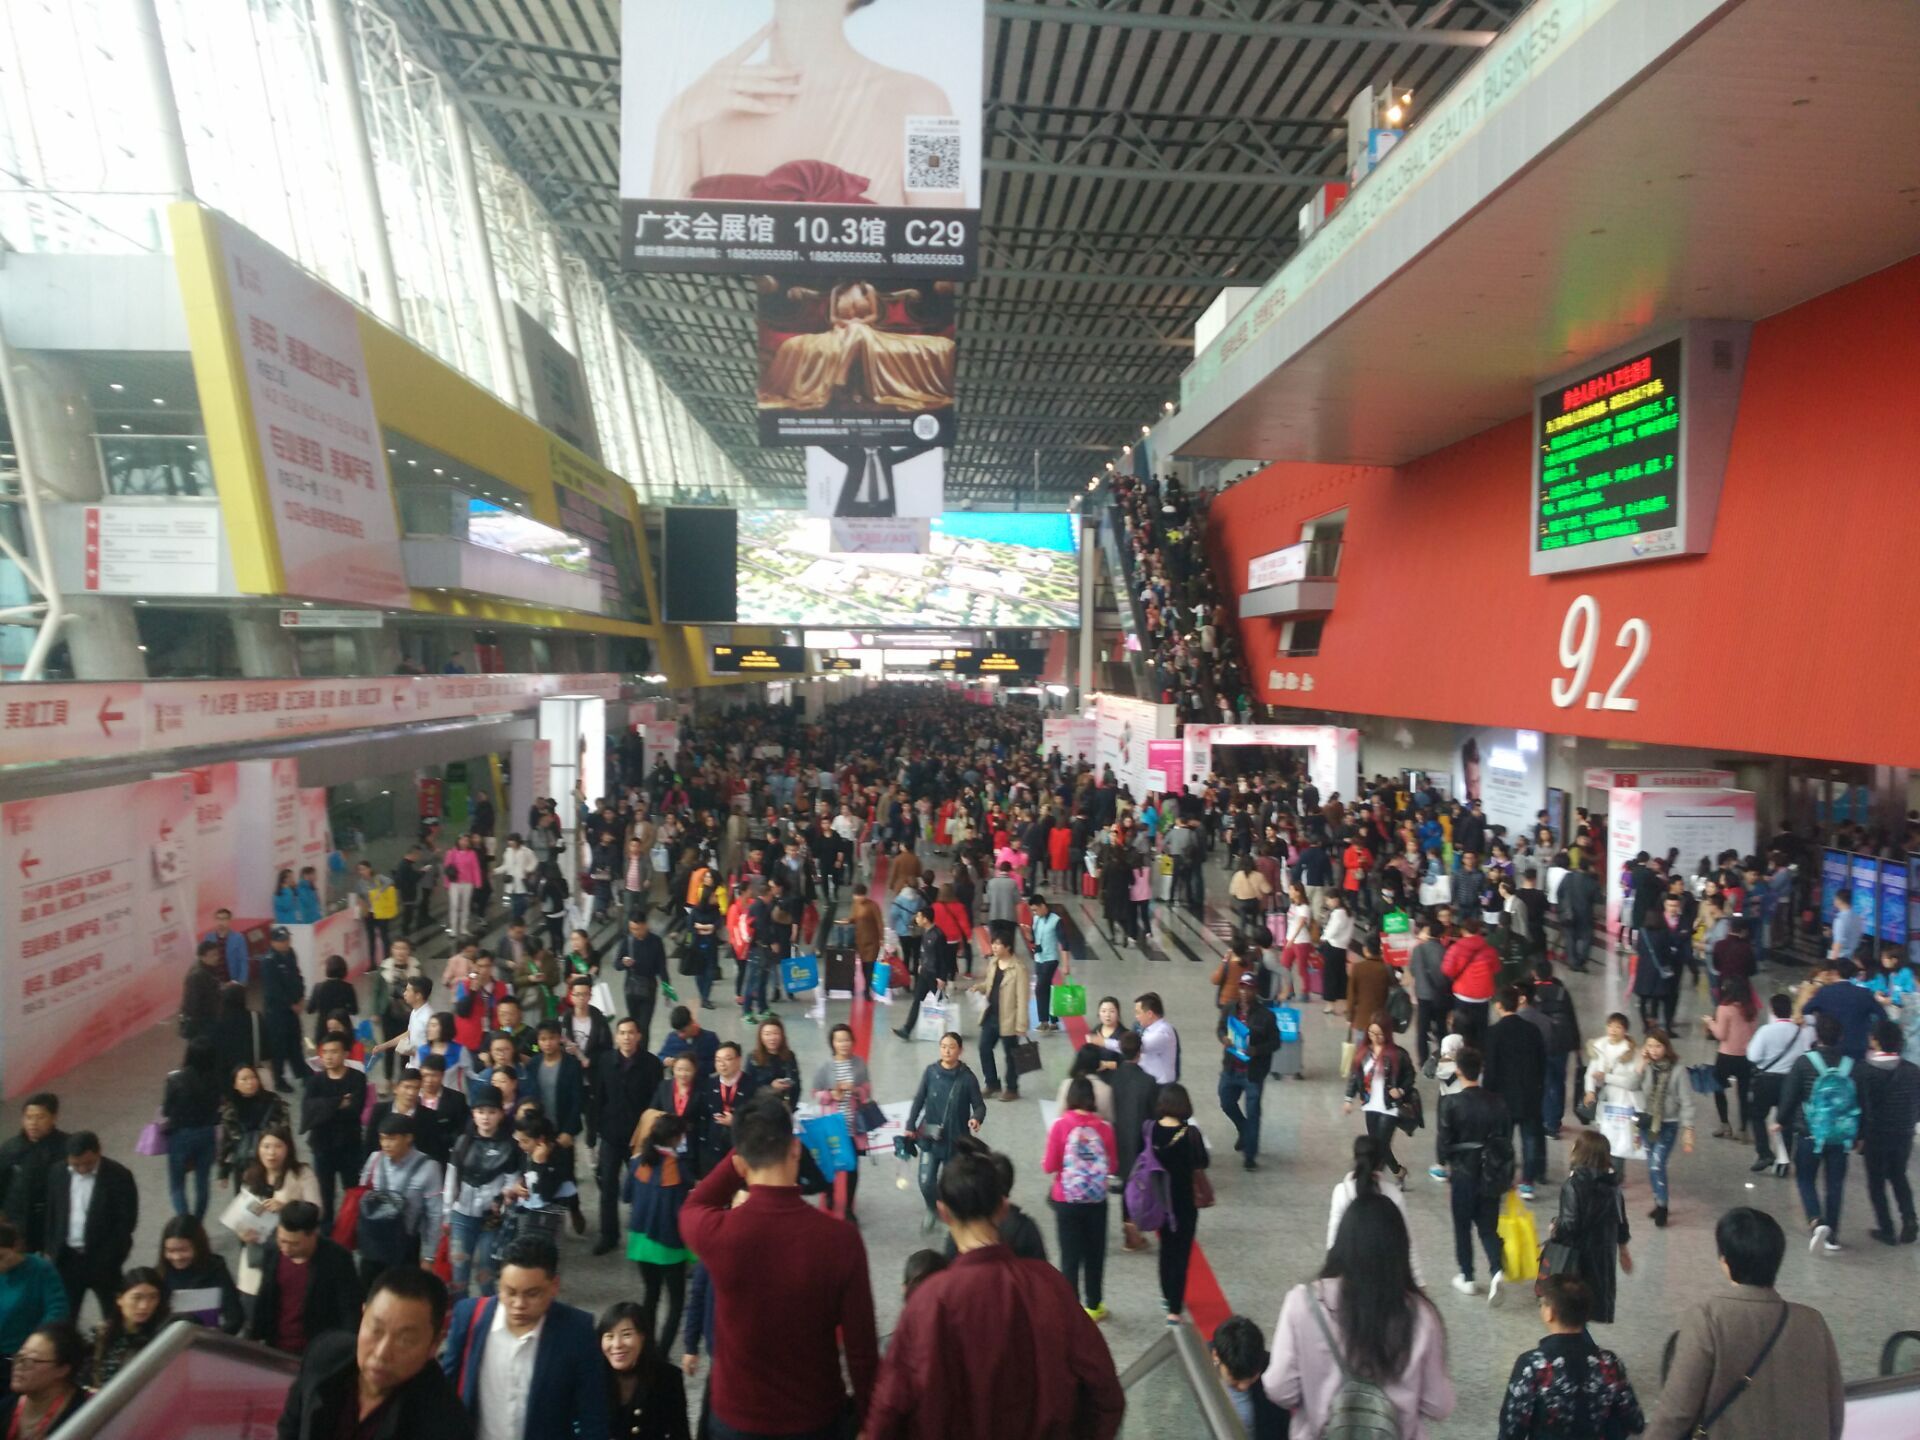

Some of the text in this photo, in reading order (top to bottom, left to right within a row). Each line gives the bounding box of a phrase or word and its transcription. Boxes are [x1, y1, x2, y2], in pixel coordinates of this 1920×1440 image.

[1429, 87, 1481, 162] BEAUTY
[1483, 8, 1561, 109] BUSINESS
[635, 211, 965, 247] 广交会展馆 10.3馆 C29
[1551, 594, 1651, 711] 9.2
